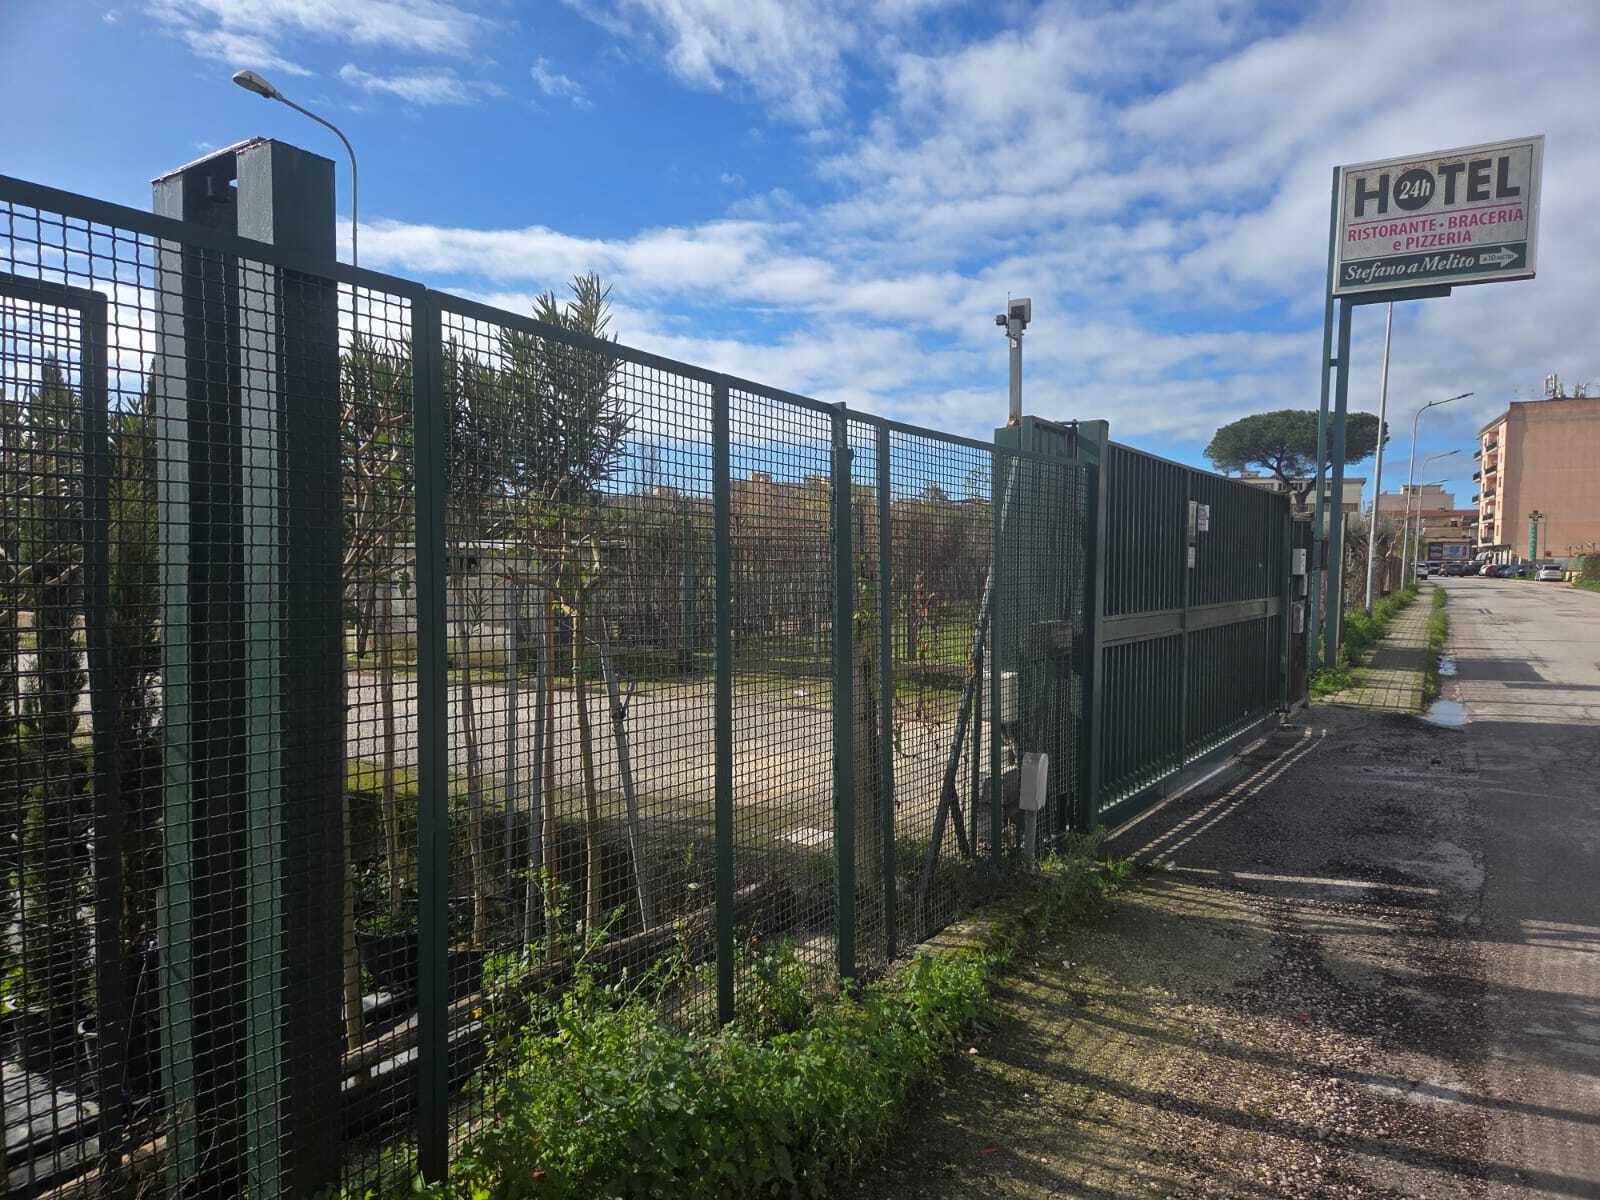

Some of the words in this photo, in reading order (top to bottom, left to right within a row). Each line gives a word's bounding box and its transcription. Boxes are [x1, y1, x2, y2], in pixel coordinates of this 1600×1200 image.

[1354, 156, 1521, 217] HOTEL
[1399, 178, 1432, 200] 24h
[1347, 218, 1437, 242] RISTORANTE
[1447, 208, 1524, 230] BRACERIA
[1393, 240, 1402, 251] e
[1405, 230, 1473, 250] PIZZERIA
[1345, 261, 1404, 283] Stefano
[1407, 262, 1418, 274] a
[1420, 254, 1475, 273] Melito
